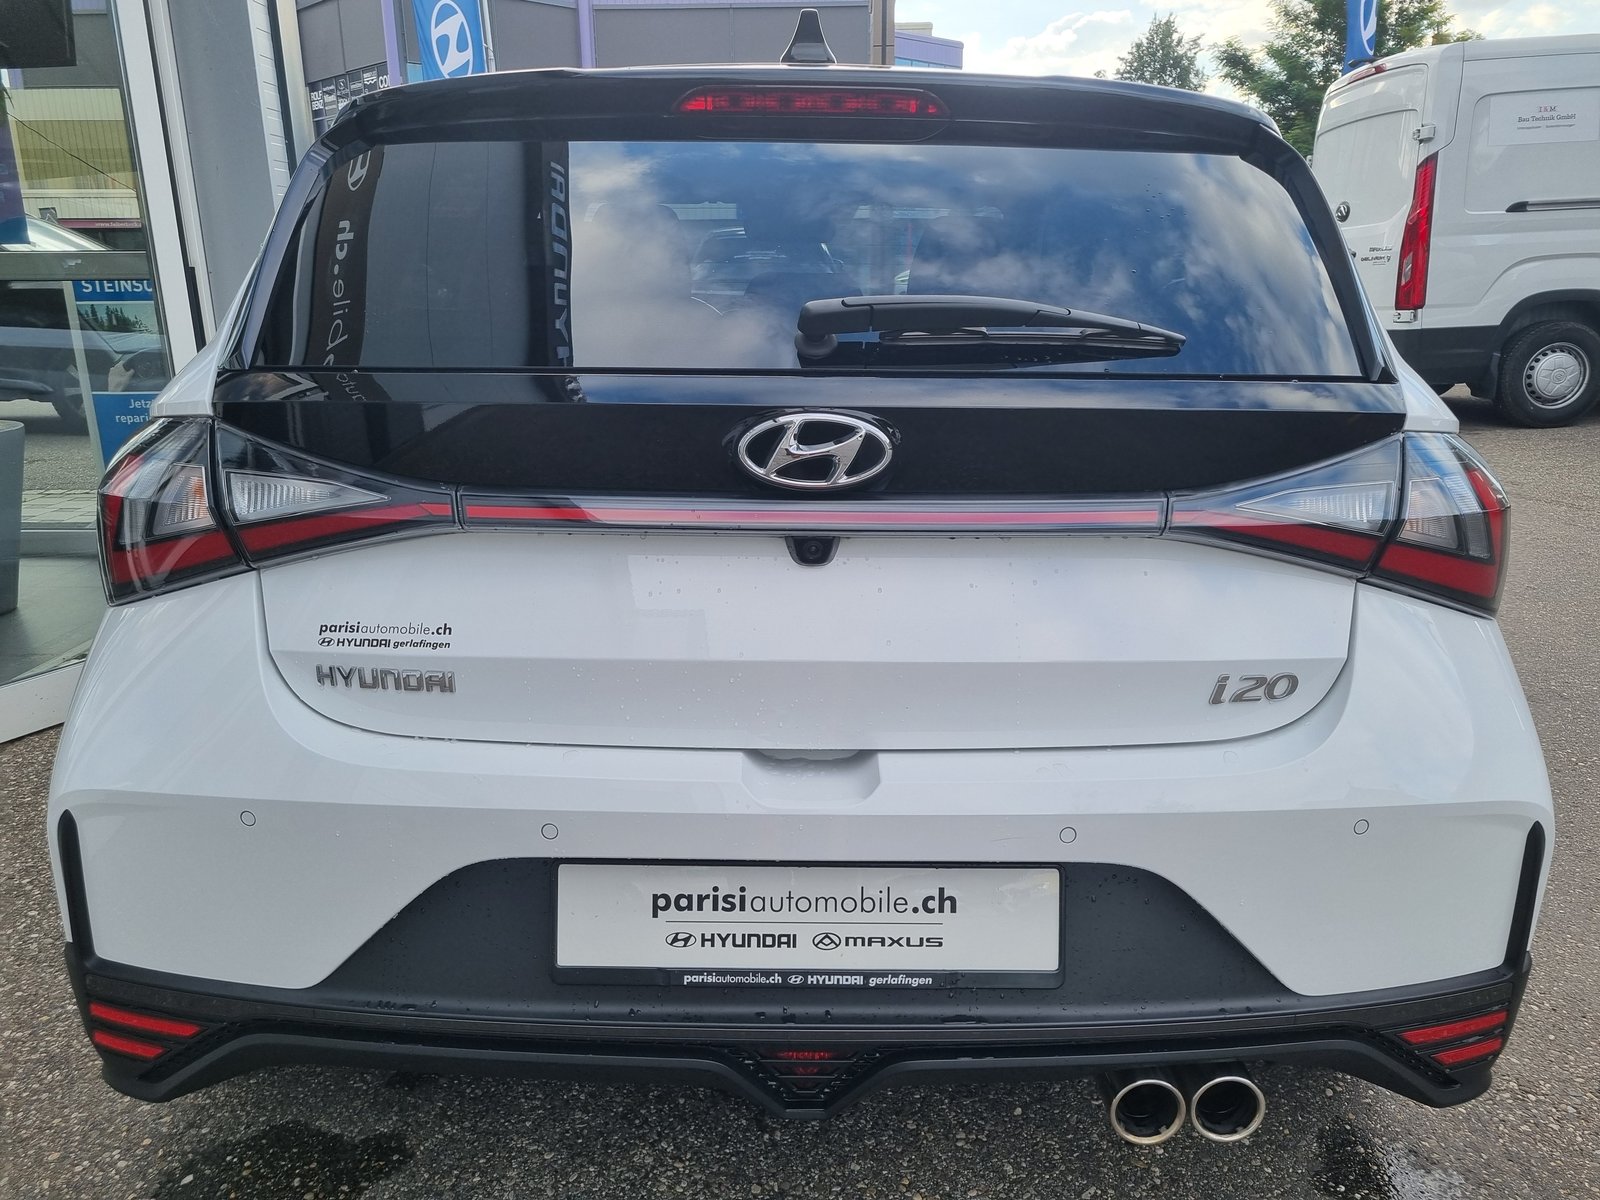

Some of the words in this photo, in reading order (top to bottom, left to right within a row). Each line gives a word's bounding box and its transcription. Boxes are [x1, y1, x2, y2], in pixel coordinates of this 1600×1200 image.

[379, 75, 389, 88] CO
[310, 91, 322, 101] ROLF
[312, 100, 323, 110] BENZ
[129, 399, 154, 409] Jetz
[318, 621, 452, 635] parisiautomobile.ch
[336, 638, 391, 648] HYUNDAI
[393, 639, 451, 650] gerlafingen
[315, 664, 456, 693] HYUNDAI
[1208, 672, 1300, 704] i20
[651, 886, 958, 918] parisiautomobile.ch
[700, 933, 797, 948] HYUNDAI
[844, 936, 944, 948] MAXUS
[683, 972, 782, 985] parisiautomobile.ch
[807, 974, 864, 985] HYUNDAI
[868, 975, 933, 986] gerlafingen
